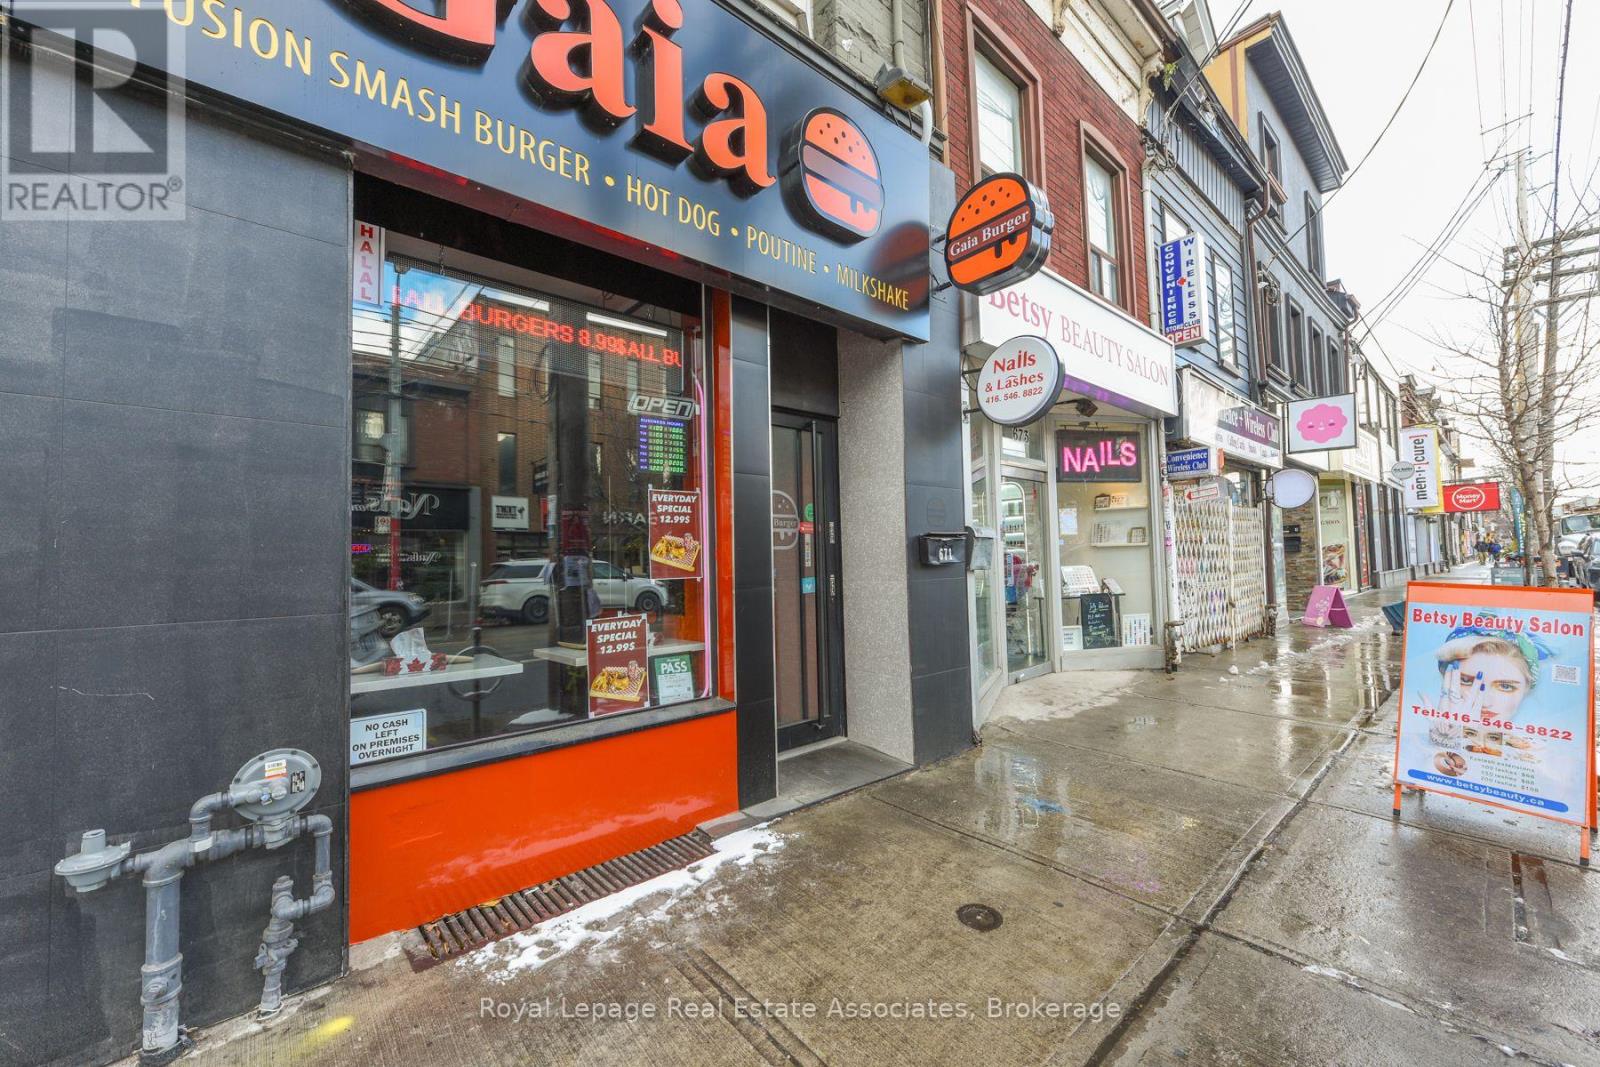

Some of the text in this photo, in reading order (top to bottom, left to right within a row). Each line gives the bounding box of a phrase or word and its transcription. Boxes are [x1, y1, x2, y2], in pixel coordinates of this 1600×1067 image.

[130, 0, 909, 312] USION SMASH BURGER HOT DOG POUTINE MILKSHAKE
[950, 210, 1029, 256] Gaia Burger
[358, 223, 374, 302] HALAL
[1164, 244, 1177, 325] CONVENIENCE
[1183, 237, 1197, 320] WIRELESS
[462, 301, 574, 344] BURGERS
[1184, 319, 1200, 328] CLUB
[1167, 327, 1200, 343] OPEN
[1060, 315, 1124, 368] BEAUTY
[1126, 348, 1169, 387] SALON
[993, 350, 1036, 374] Nails
[985, 372, 1044, 393] & Lashes
[1022, 386, 1043, 398] 8822
[632, 395, 692, 417] OPEN
[1012, 426, 1029, 443] 673
[1063, 440, 1136, 473] NAILS
[1167, 451, 1208, 463] Convenience
[1167, 460, 1208, 472] Wireless Club
[652, 493, 698, 503] EVERYDAY
[656, 504, 692, 513] SPECIAL
[659, 515, 690, 524] 12.99$
[938, 547, 953, 561] 671
[591, 619, 643, 632] EVERYDAY
[1412, 608, 1584, 637] Betsy Beauty Salon
[596, 631, 637, 643] SPECIAL
[600, 641, 636, 654] 12.99$
[660, 661, 688, 674] PASS
[365, 718, 408, 732] NO CASH
[1411, 705, 1575, 741] Tel:416-546-8822
[375, 728, 399, 739] LEFT
[352, 734, 420, 752] ON PREMISES
[358, 744, 415, 760] OVERNIGHT
[1426, 774, 1545, 806] www.betsybeauty.ca
